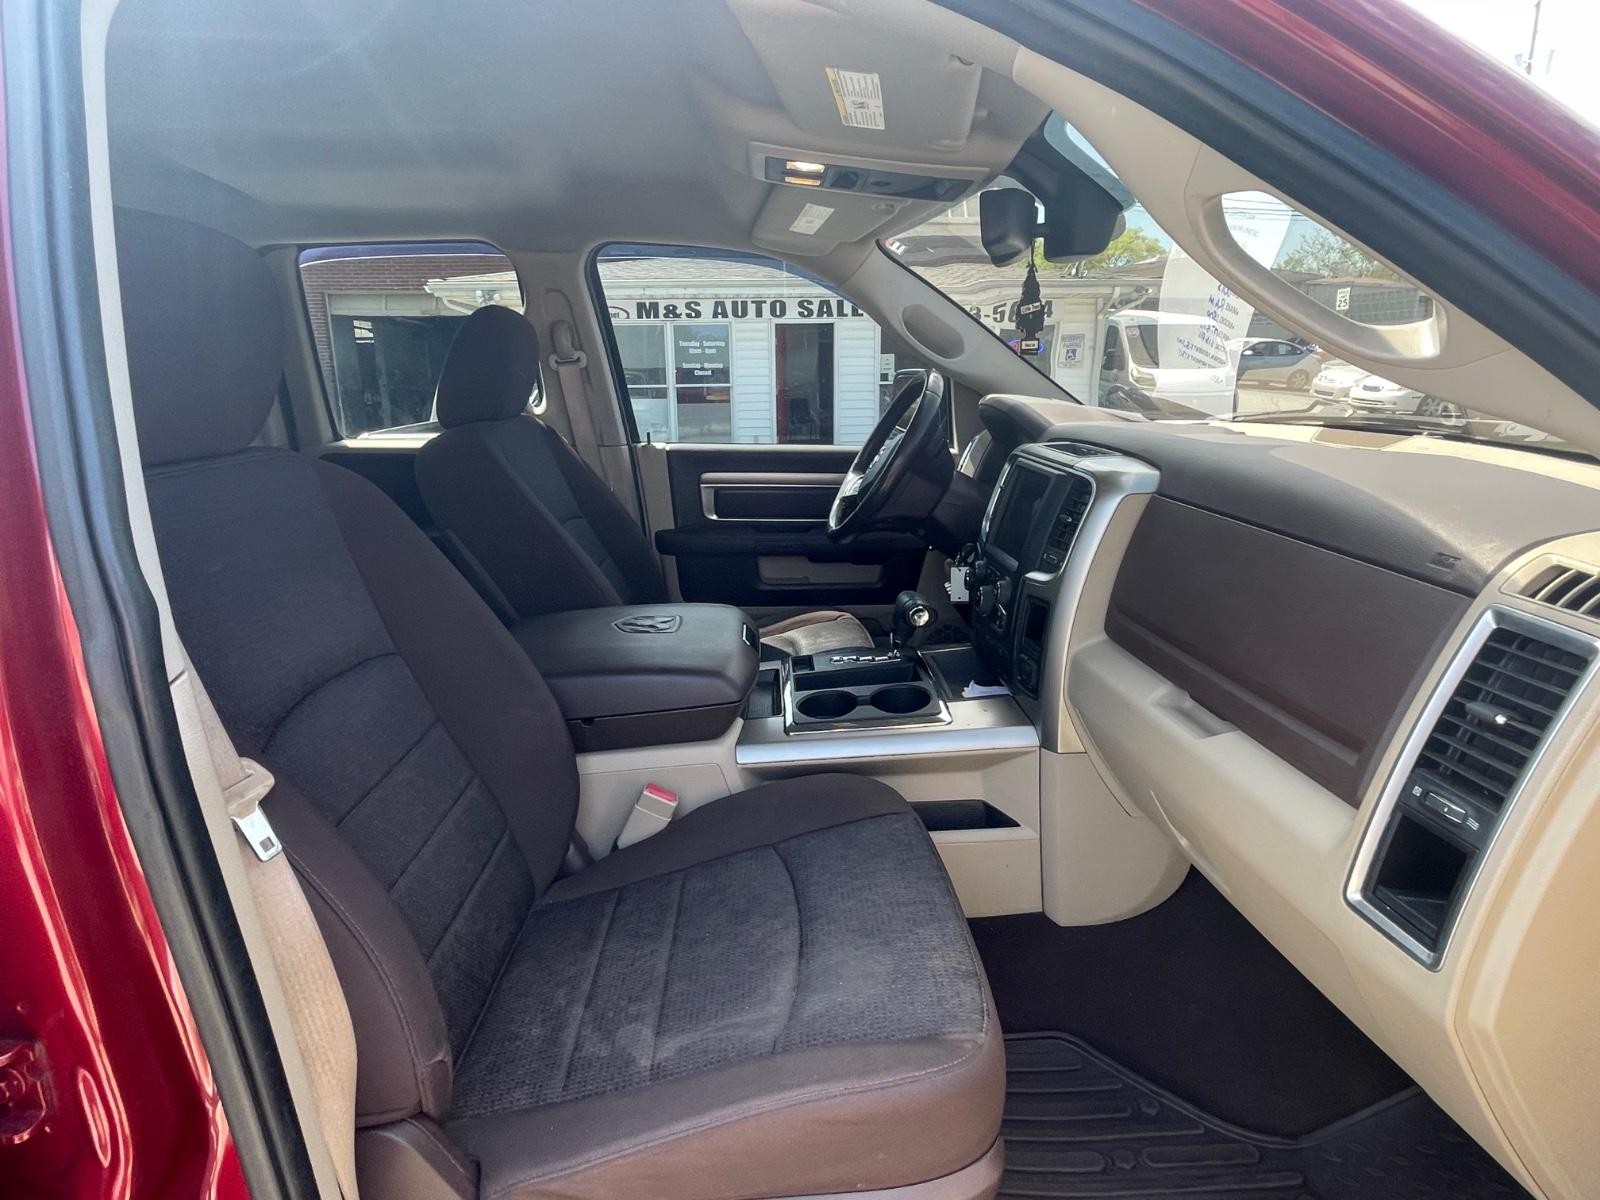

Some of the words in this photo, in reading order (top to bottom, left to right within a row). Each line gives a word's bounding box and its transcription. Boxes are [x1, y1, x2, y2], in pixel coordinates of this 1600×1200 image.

[636, 301, 701, 319] M&S
[712, 300, 786, 319] AUTO
[1337, 299, 1348, 308] 25
